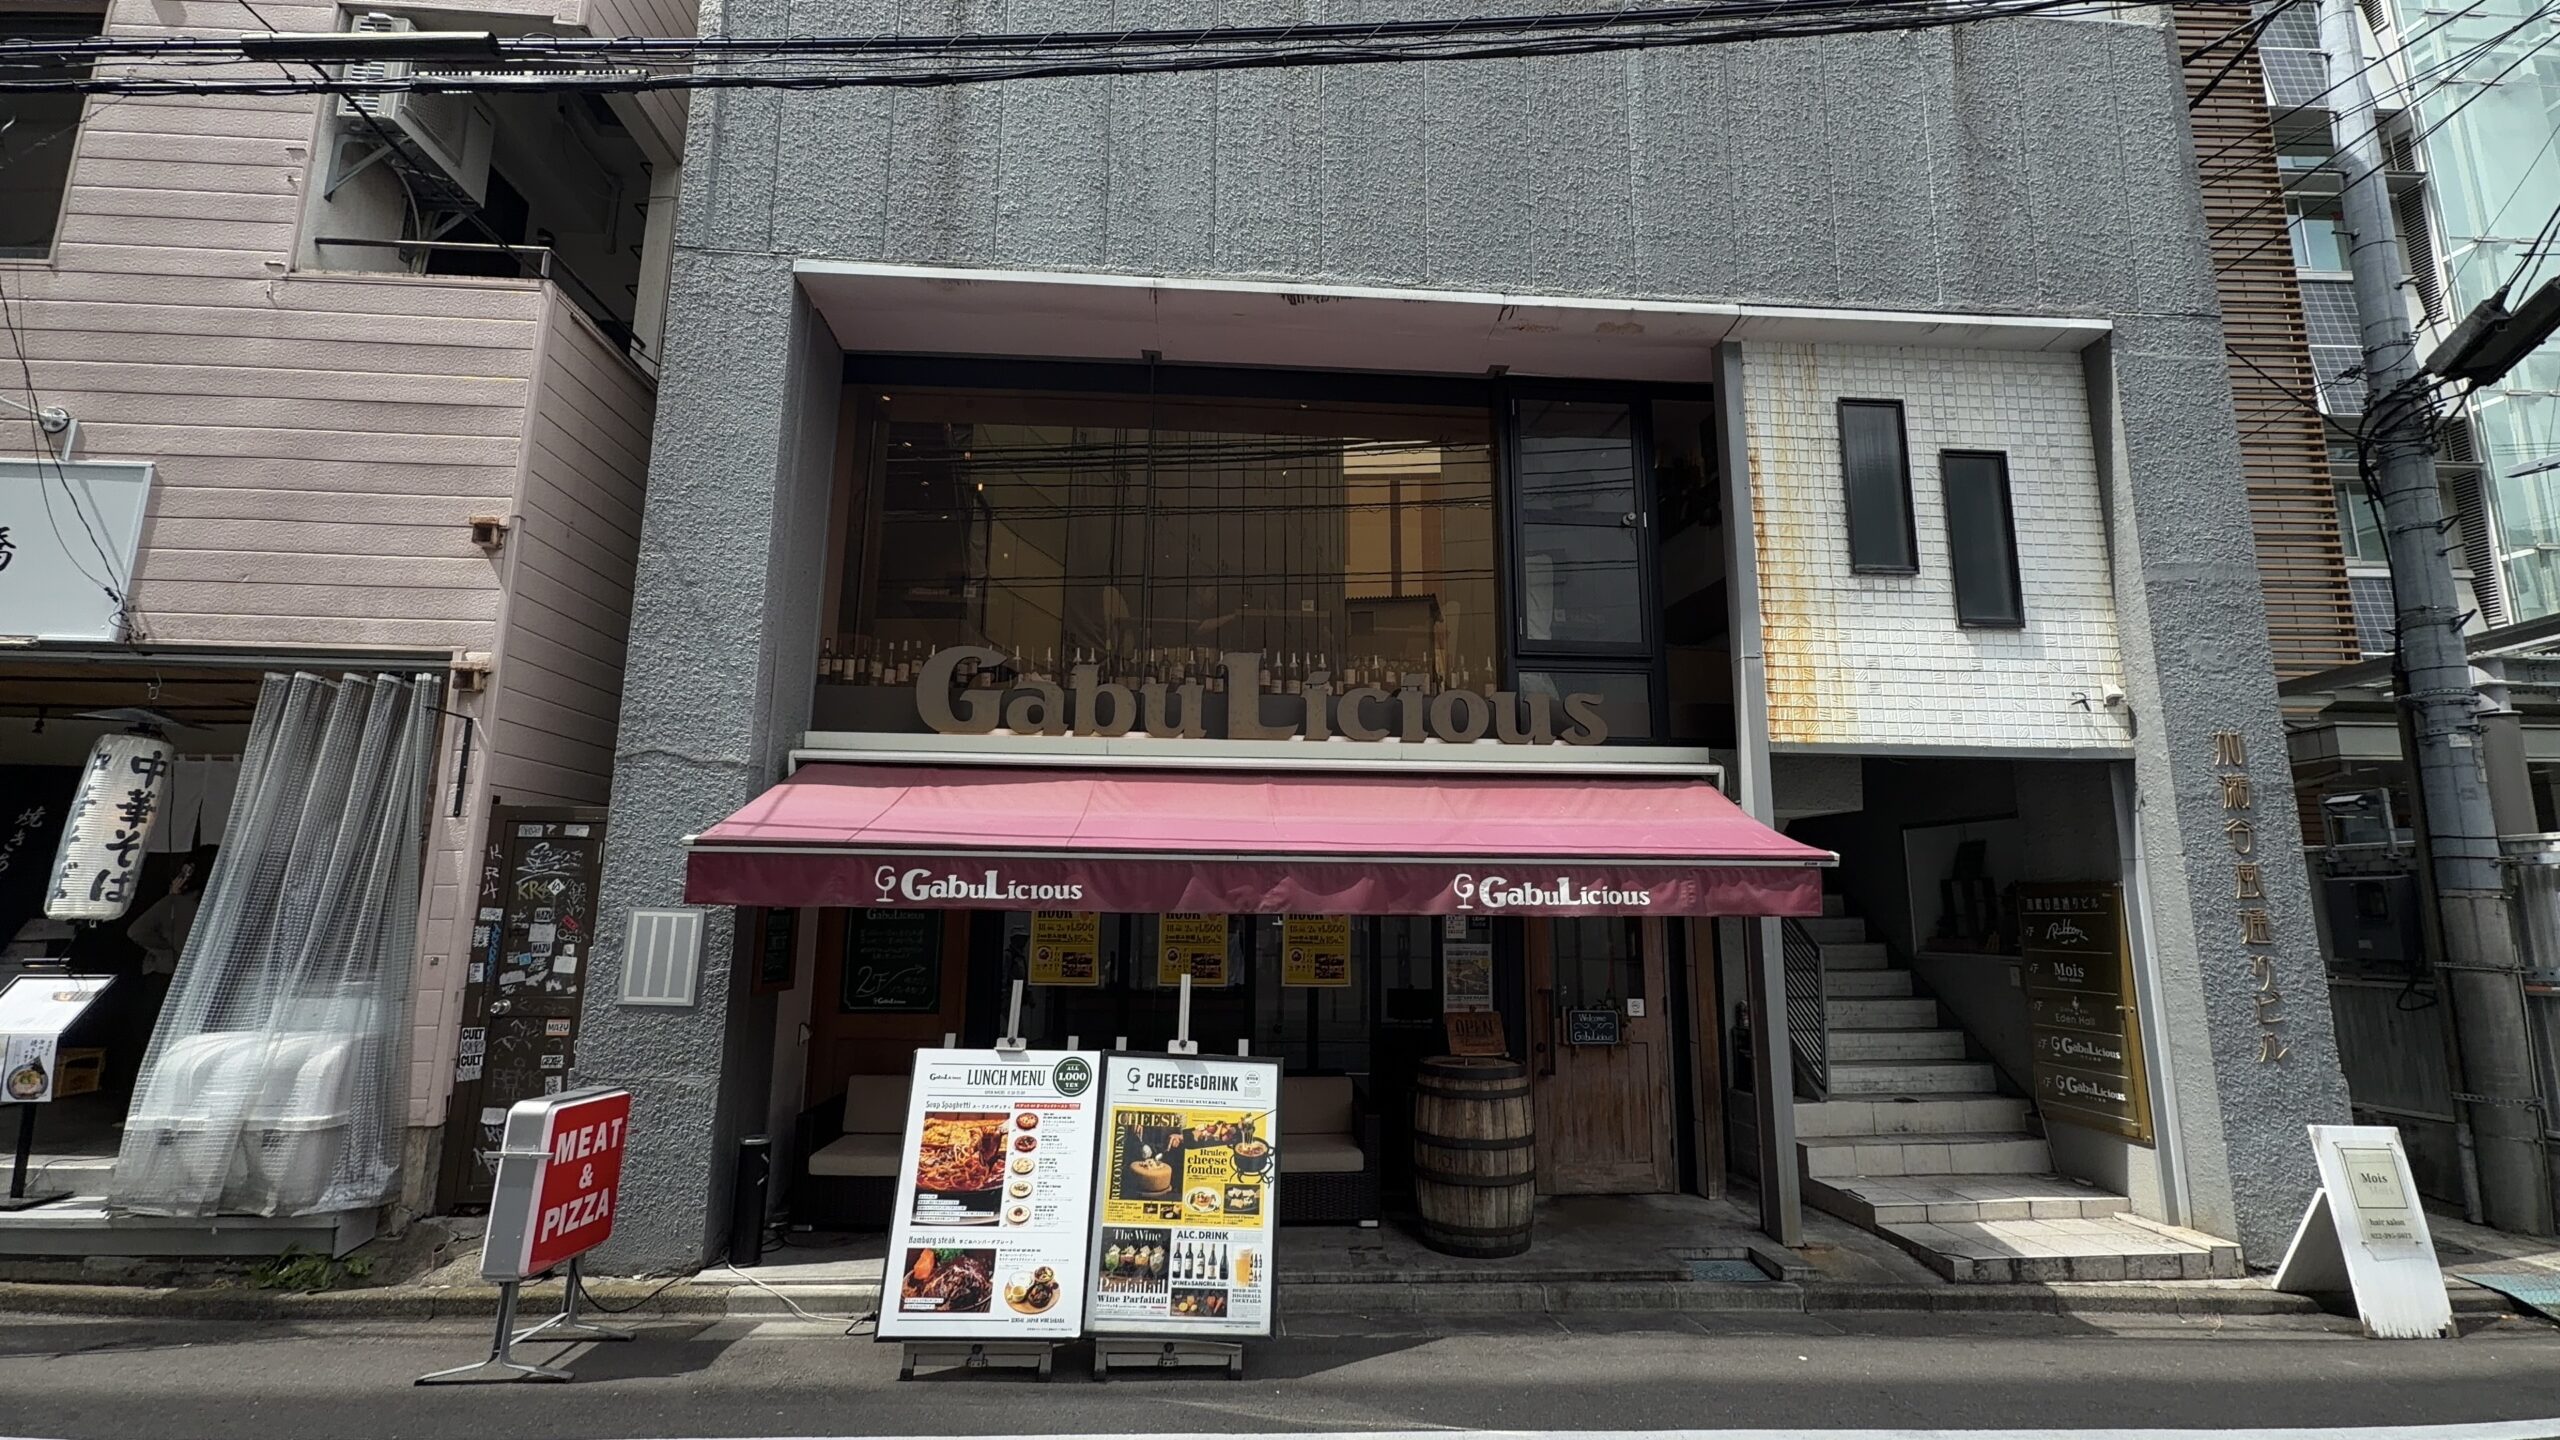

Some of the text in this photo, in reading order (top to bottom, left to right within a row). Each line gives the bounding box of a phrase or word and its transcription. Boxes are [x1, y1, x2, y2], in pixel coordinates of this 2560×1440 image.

[915, 645, 1609, 746] GabuLicious
[90, 751, 167, 903] 中華そば
[900, 868, 1083, 901] GabuLicious
[1478, 876, 1651, 908] GabuLicious
[2053, 962, 2085, 978] Mois
[462, 1028, 484, 1040] CULT
[461, 1054, 482, 1066] CULT
[967, 1069, 1008, 1086] LUNCH
[1010, 1070, 1046, 1086] MENU
[1058, 1072, 1087, 1081] 1,000
[941, 1101, 971, 1110] Spaghetti
[553, 1117, 623, 1166] MEAT
[1187, 1155, 1228, 1166] cheese
[578, 1163, 594, 1189] &
[1187, 1165, 1227, 1175] fondue
[2361, 1172, 2388, 1184] Mois
[540, 1187, 609, 1244] PIZZA
[1114, 1229, 1162, 1241] The Wine
[1097, 1295, 1121, 1303] Wine
